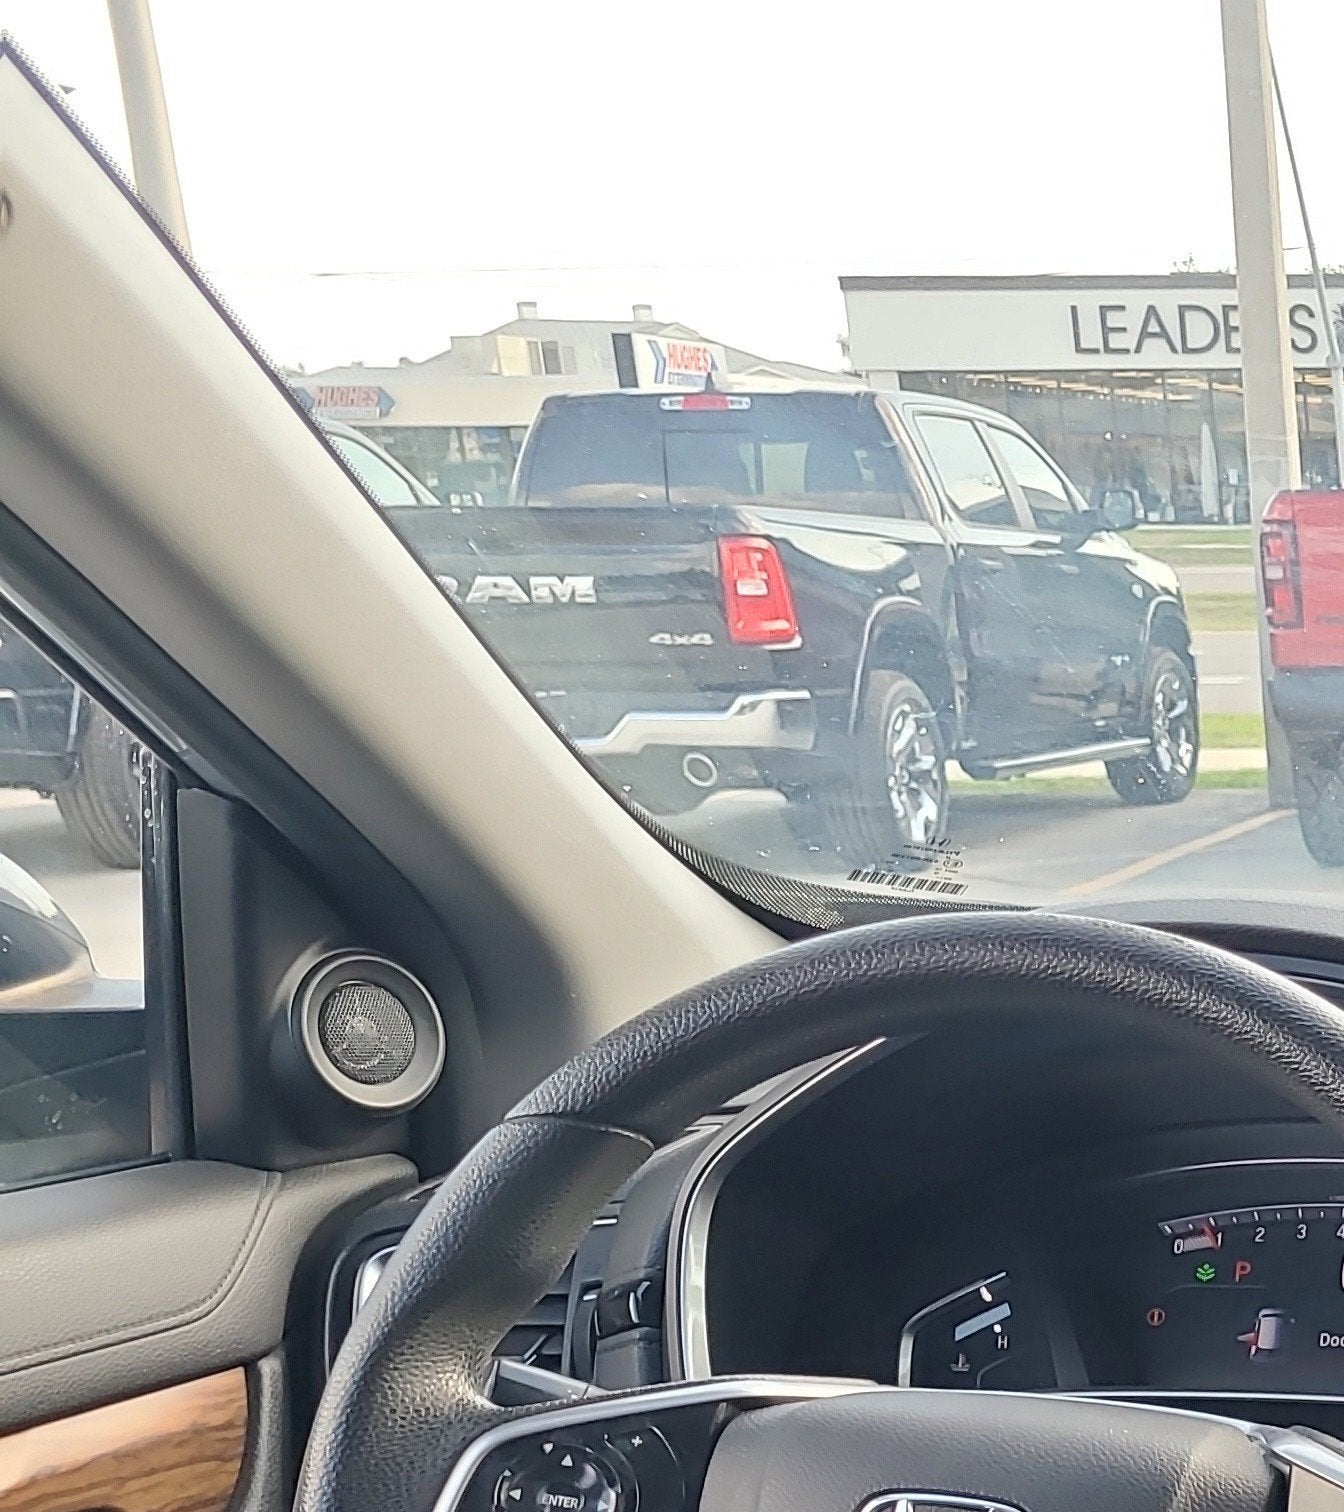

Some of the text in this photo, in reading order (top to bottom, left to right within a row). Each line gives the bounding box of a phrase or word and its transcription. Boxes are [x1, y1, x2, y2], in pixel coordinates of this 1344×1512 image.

[1070, 303, 1318, 355] LEADES
[648, 632, 714, 646] 4x4
[1254, 1227, 1266, 1243] 2
[1296, 1224, 1308, 1240] 3
[1235, 1260, 1252, 1283] P
[997, 1334, 1008, 1350] H
[541, 1493, 579, 1509] ENTER
